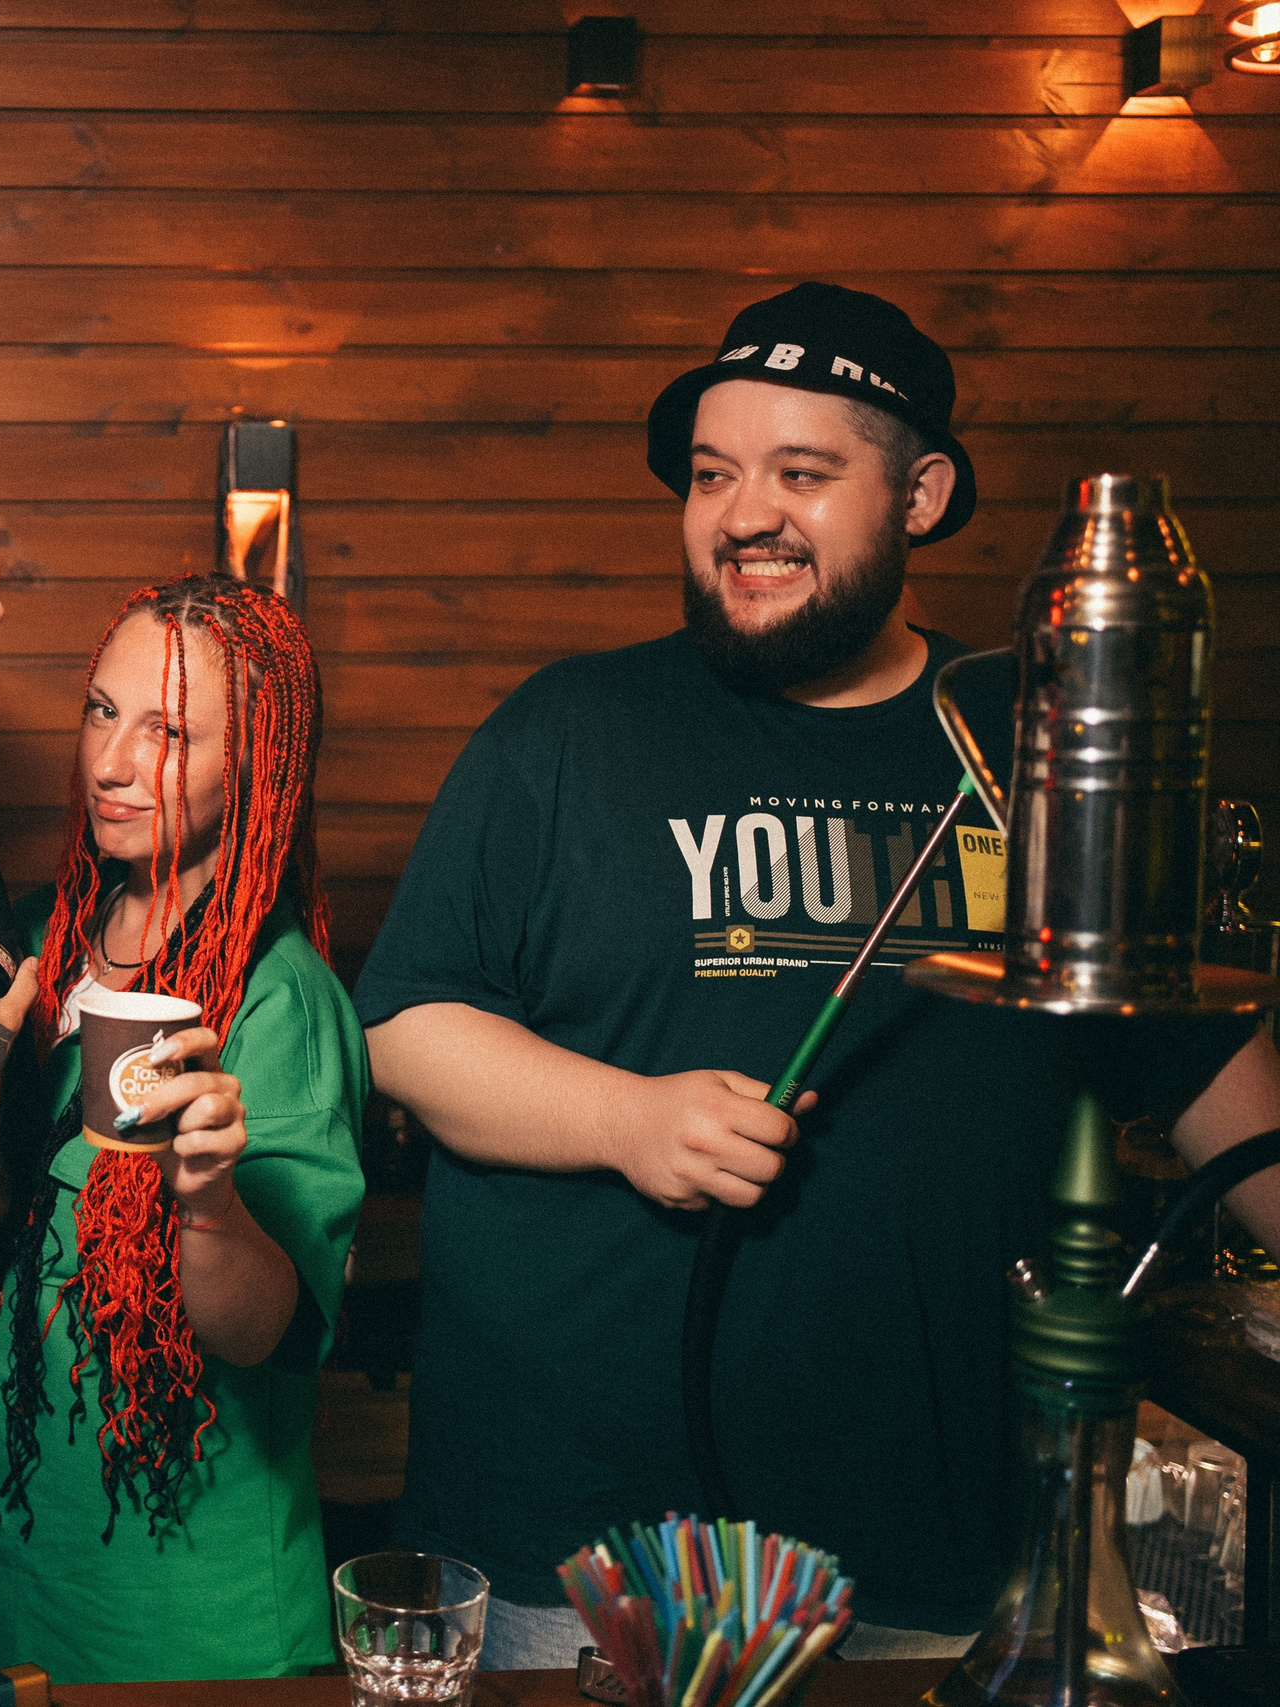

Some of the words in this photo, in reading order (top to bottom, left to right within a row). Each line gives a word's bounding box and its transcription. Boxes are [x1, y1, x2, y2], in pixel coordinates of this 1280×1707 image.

[750, 796, 843, 809] MOVING
[852, 800, 946, 814] FORWAR
[963, 833, 1009, 856] ONE
[973, 891, 999, 901] NEW
[694, 957, 741, 967] SUPERIOR
[743, 957, 775, 966] URBAN
[776, 959, 809, 968] BRAND
[694, 969, 737, 978] PREMIUM
[739, 969, 778, 977] QUALITY
[130, 1065, 175, 1082] Taste
